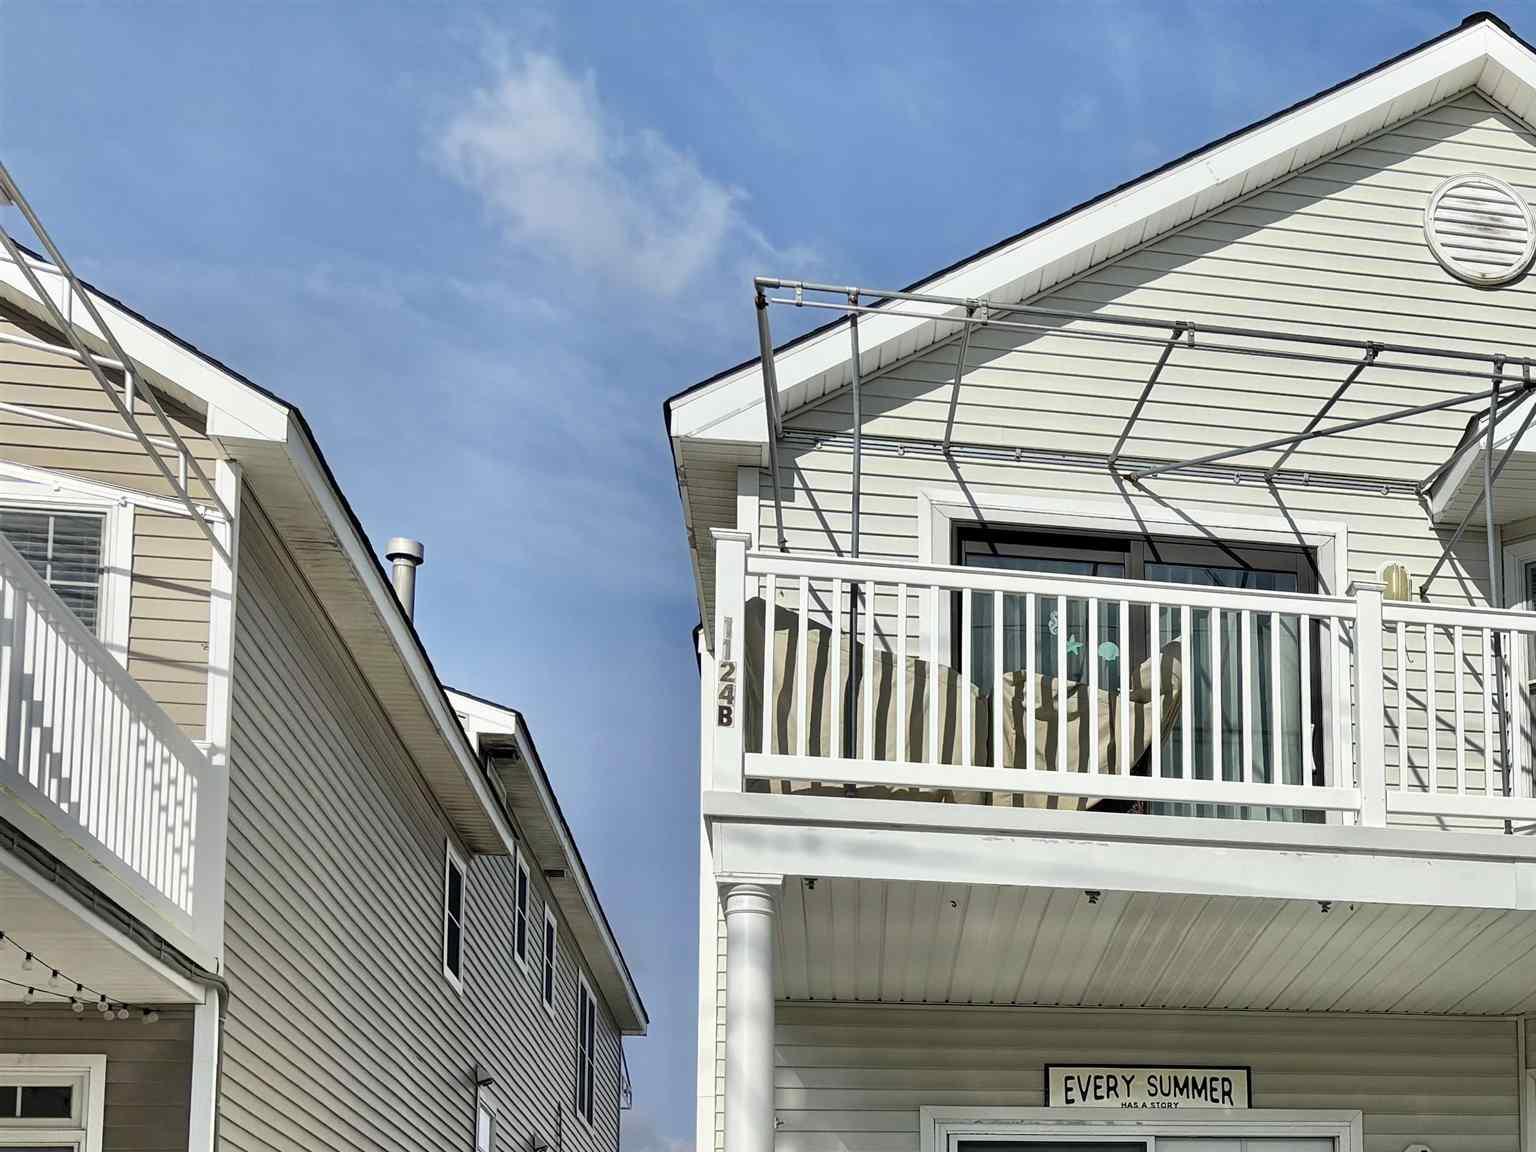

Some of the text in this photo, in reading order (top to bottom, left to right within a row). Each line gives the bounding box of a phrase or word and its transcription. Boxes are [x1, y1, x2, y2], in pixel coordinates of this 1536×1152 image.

[718, 616, 736, 727] 1124B
[1064, 1075, 1234, 1106] EVERY SUMMER
